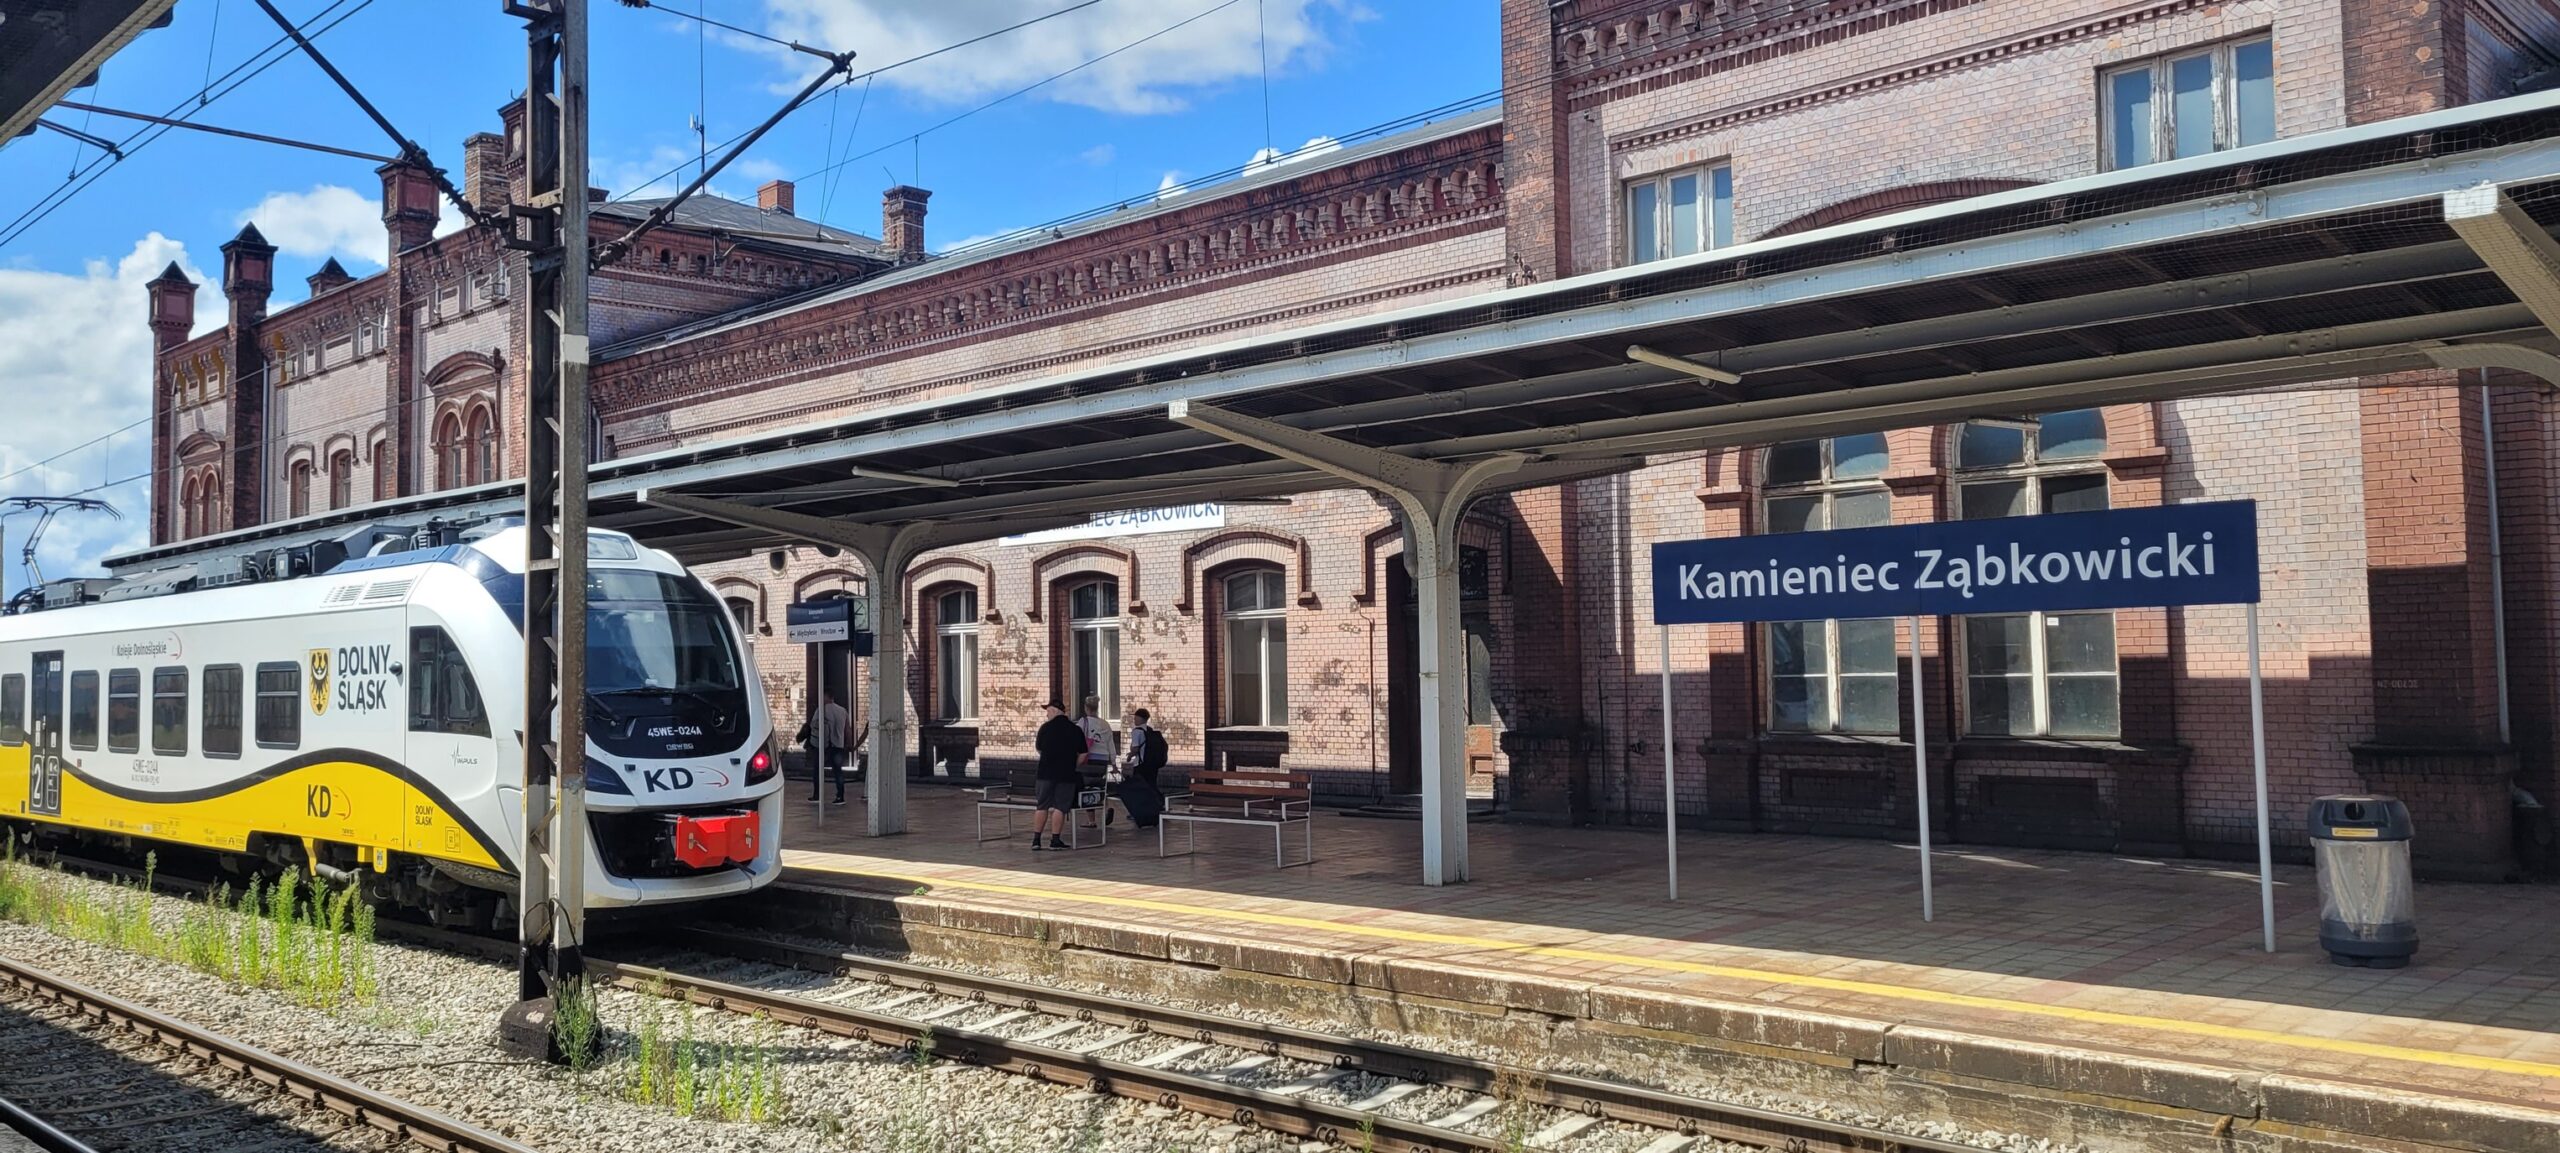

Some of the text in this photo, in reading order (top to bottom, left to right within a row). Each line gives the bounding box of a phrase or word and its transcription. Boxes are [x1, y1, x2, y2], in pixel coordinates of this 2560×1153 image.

[1679, 531, 2215, 600] Kamieniec Ząbkowicki
[338, 644, 391, 676] DOLNY
[338, 674, 387, 715] ŚLĄSK
[648, 725, 703, 738] 45WE-024A
[34, 763, 41, 799] 2
[643, 766, 695, 794] KD
[307, 783, 332, 818] KD
